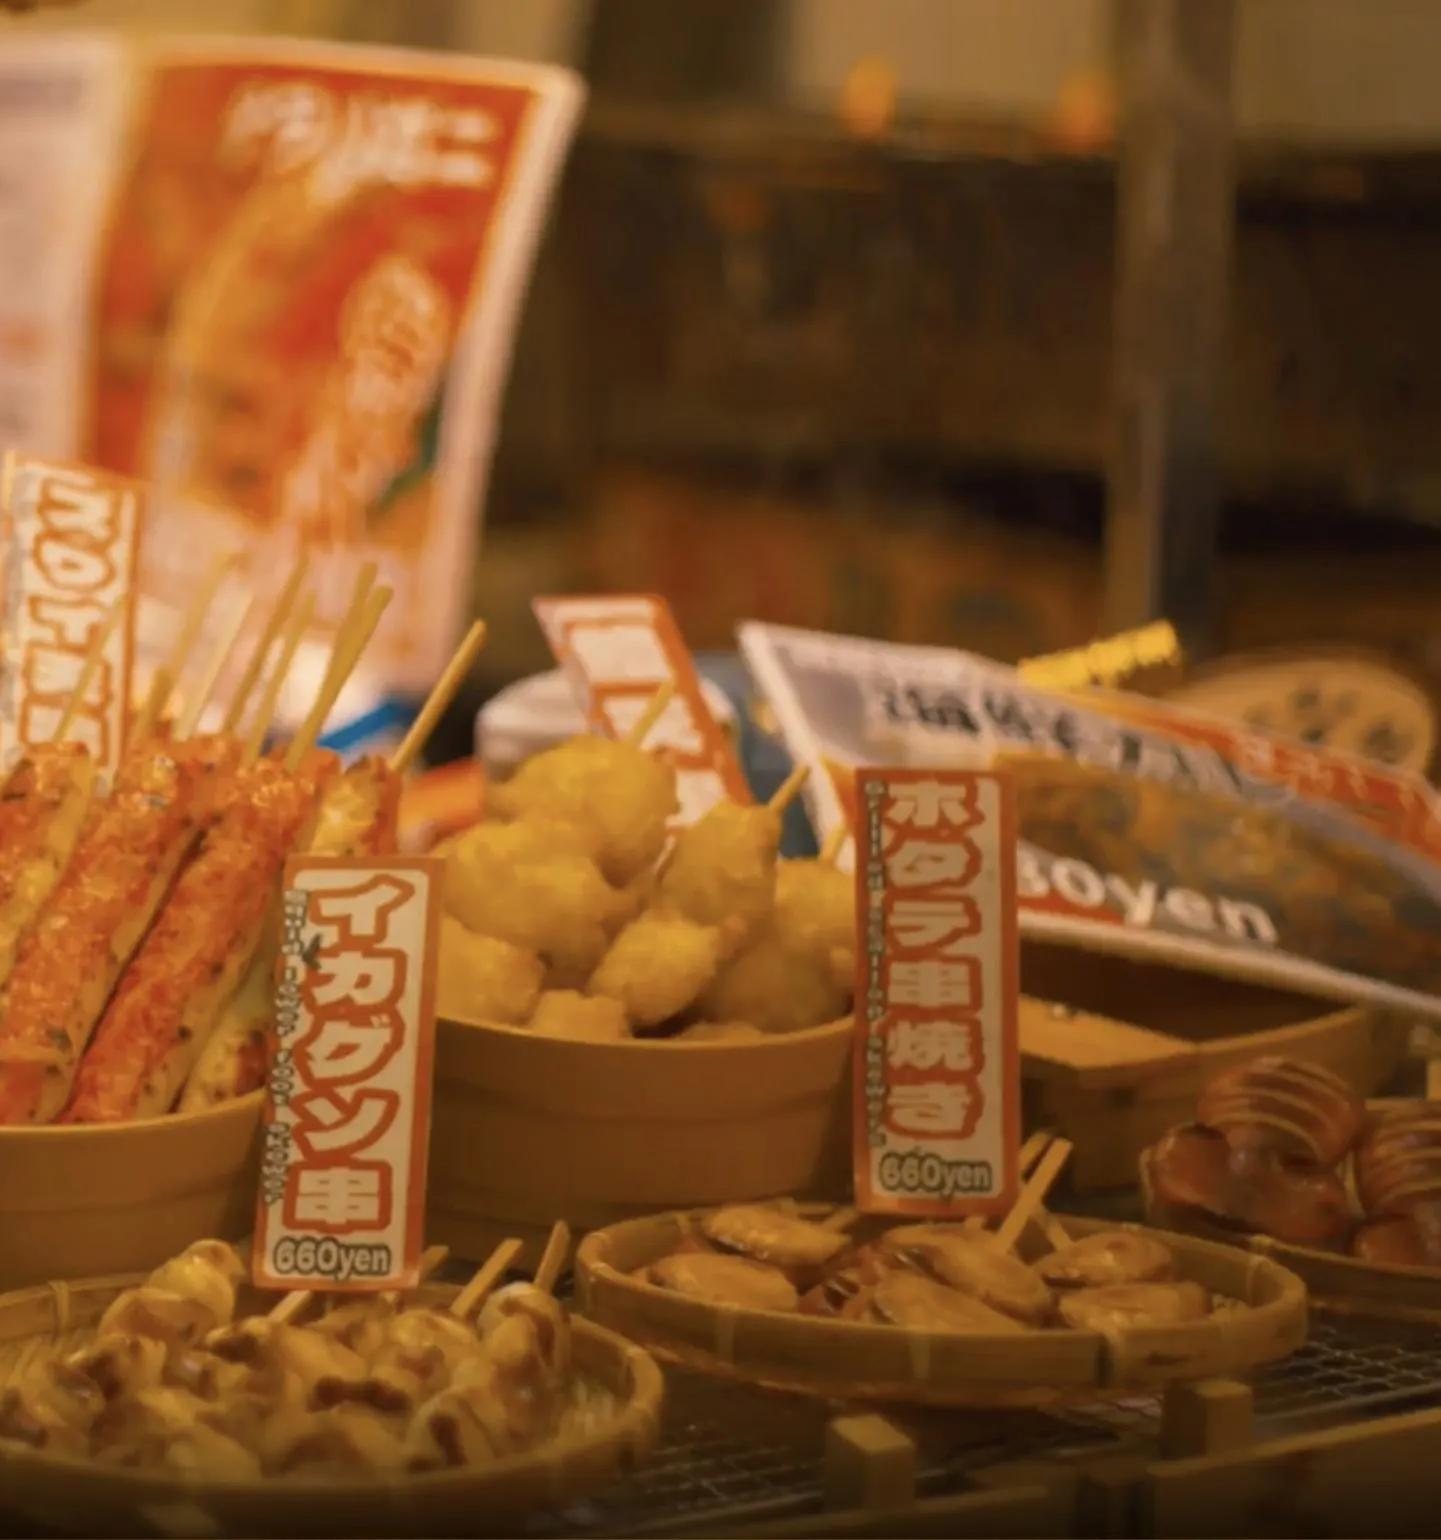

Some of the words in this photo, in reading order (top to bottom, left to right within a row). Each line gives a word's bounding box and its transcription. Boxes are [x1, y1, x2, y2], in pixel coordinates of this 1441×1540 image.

[883, 775, 981, 1138] ホタテ串焼き
[879, 1152, 993, 1198] 660yen
[273, 1236, 392, 1281] 660yen
